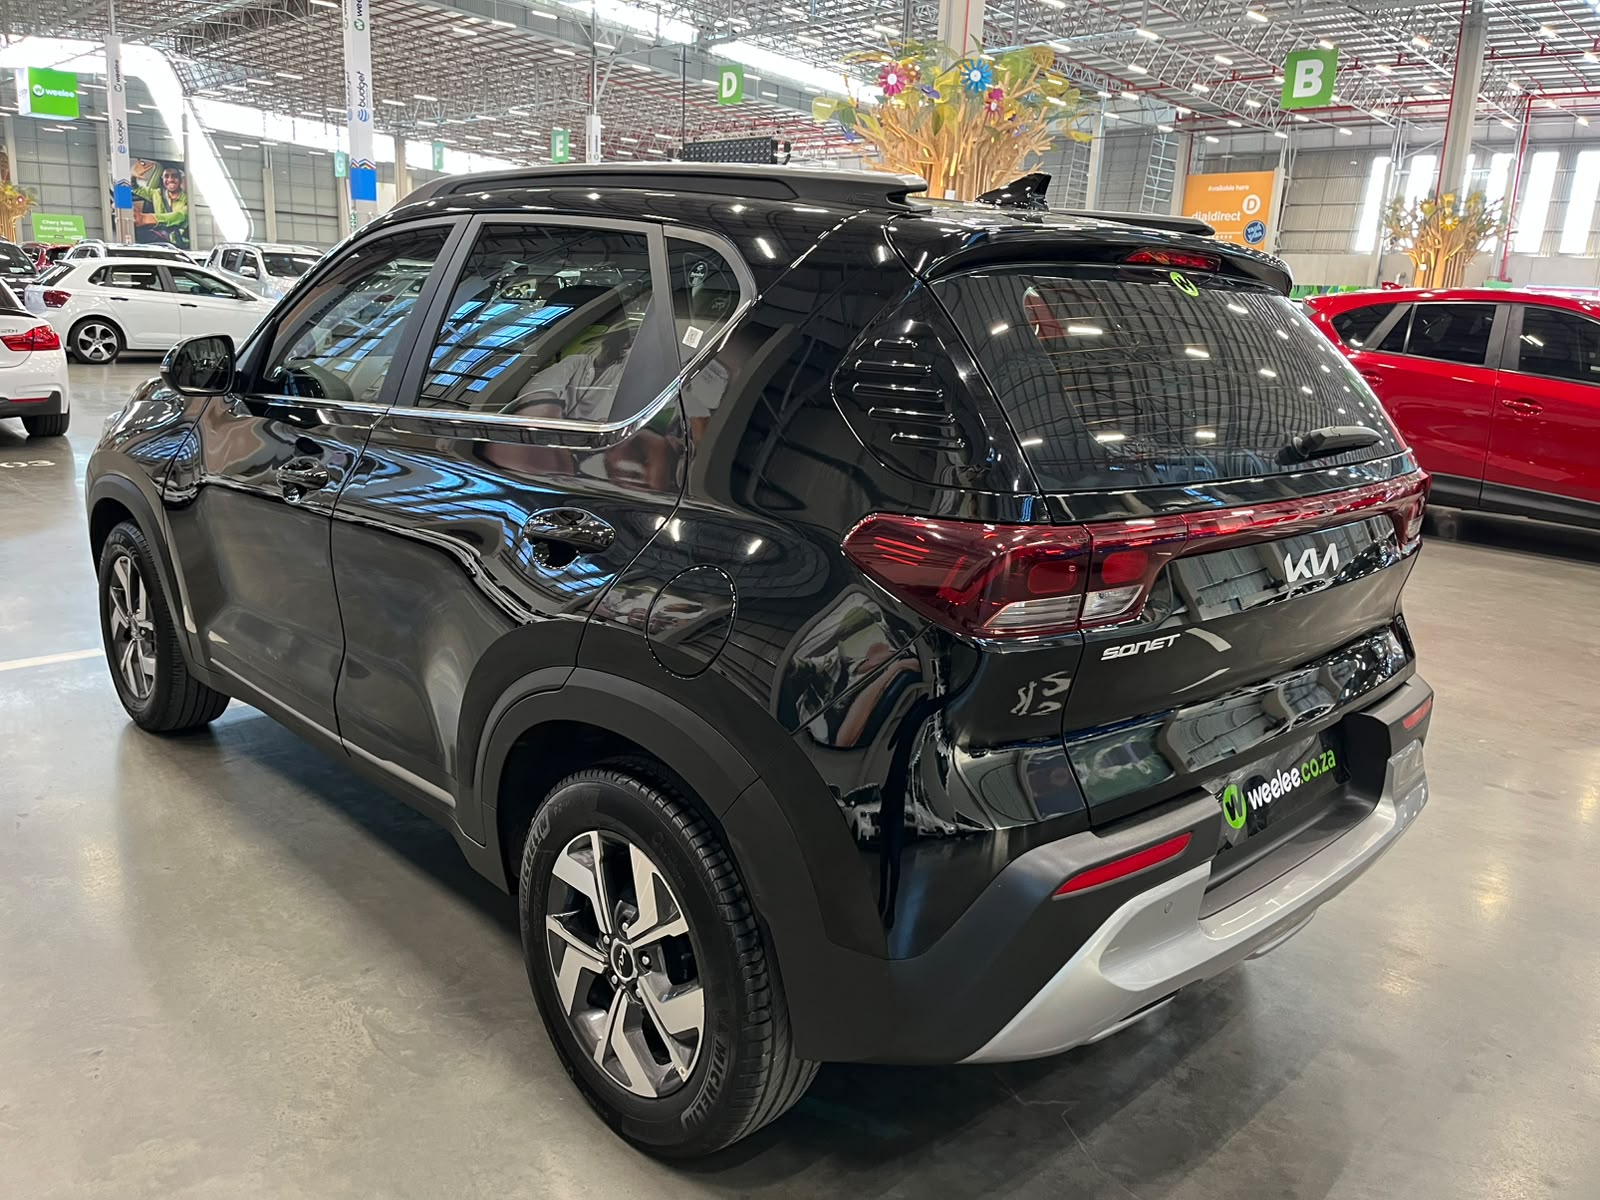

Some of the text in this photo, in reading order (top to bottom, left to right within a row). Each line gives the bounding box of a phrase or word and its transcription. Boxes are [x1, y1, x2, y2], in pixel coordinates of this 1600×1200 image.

[356, 71, 368, 107] budget
[721, 71, 738, 98] D
[1292, 59, 1324, 99] B
[45, 89, 75, 98] weelee
[116, 119, 126, 144] budget
[434, 146, 441, 166] F
[555, 134, 565, 157] E
[336, 156, 344, 173] G
[1191, 210, 1241, 222] dialdirect
[1283, 543, 1339, 583] KIA
[1101, 633, 1181, 661] SONET
[1247, 749, 1337, 810] weelee.co.za
